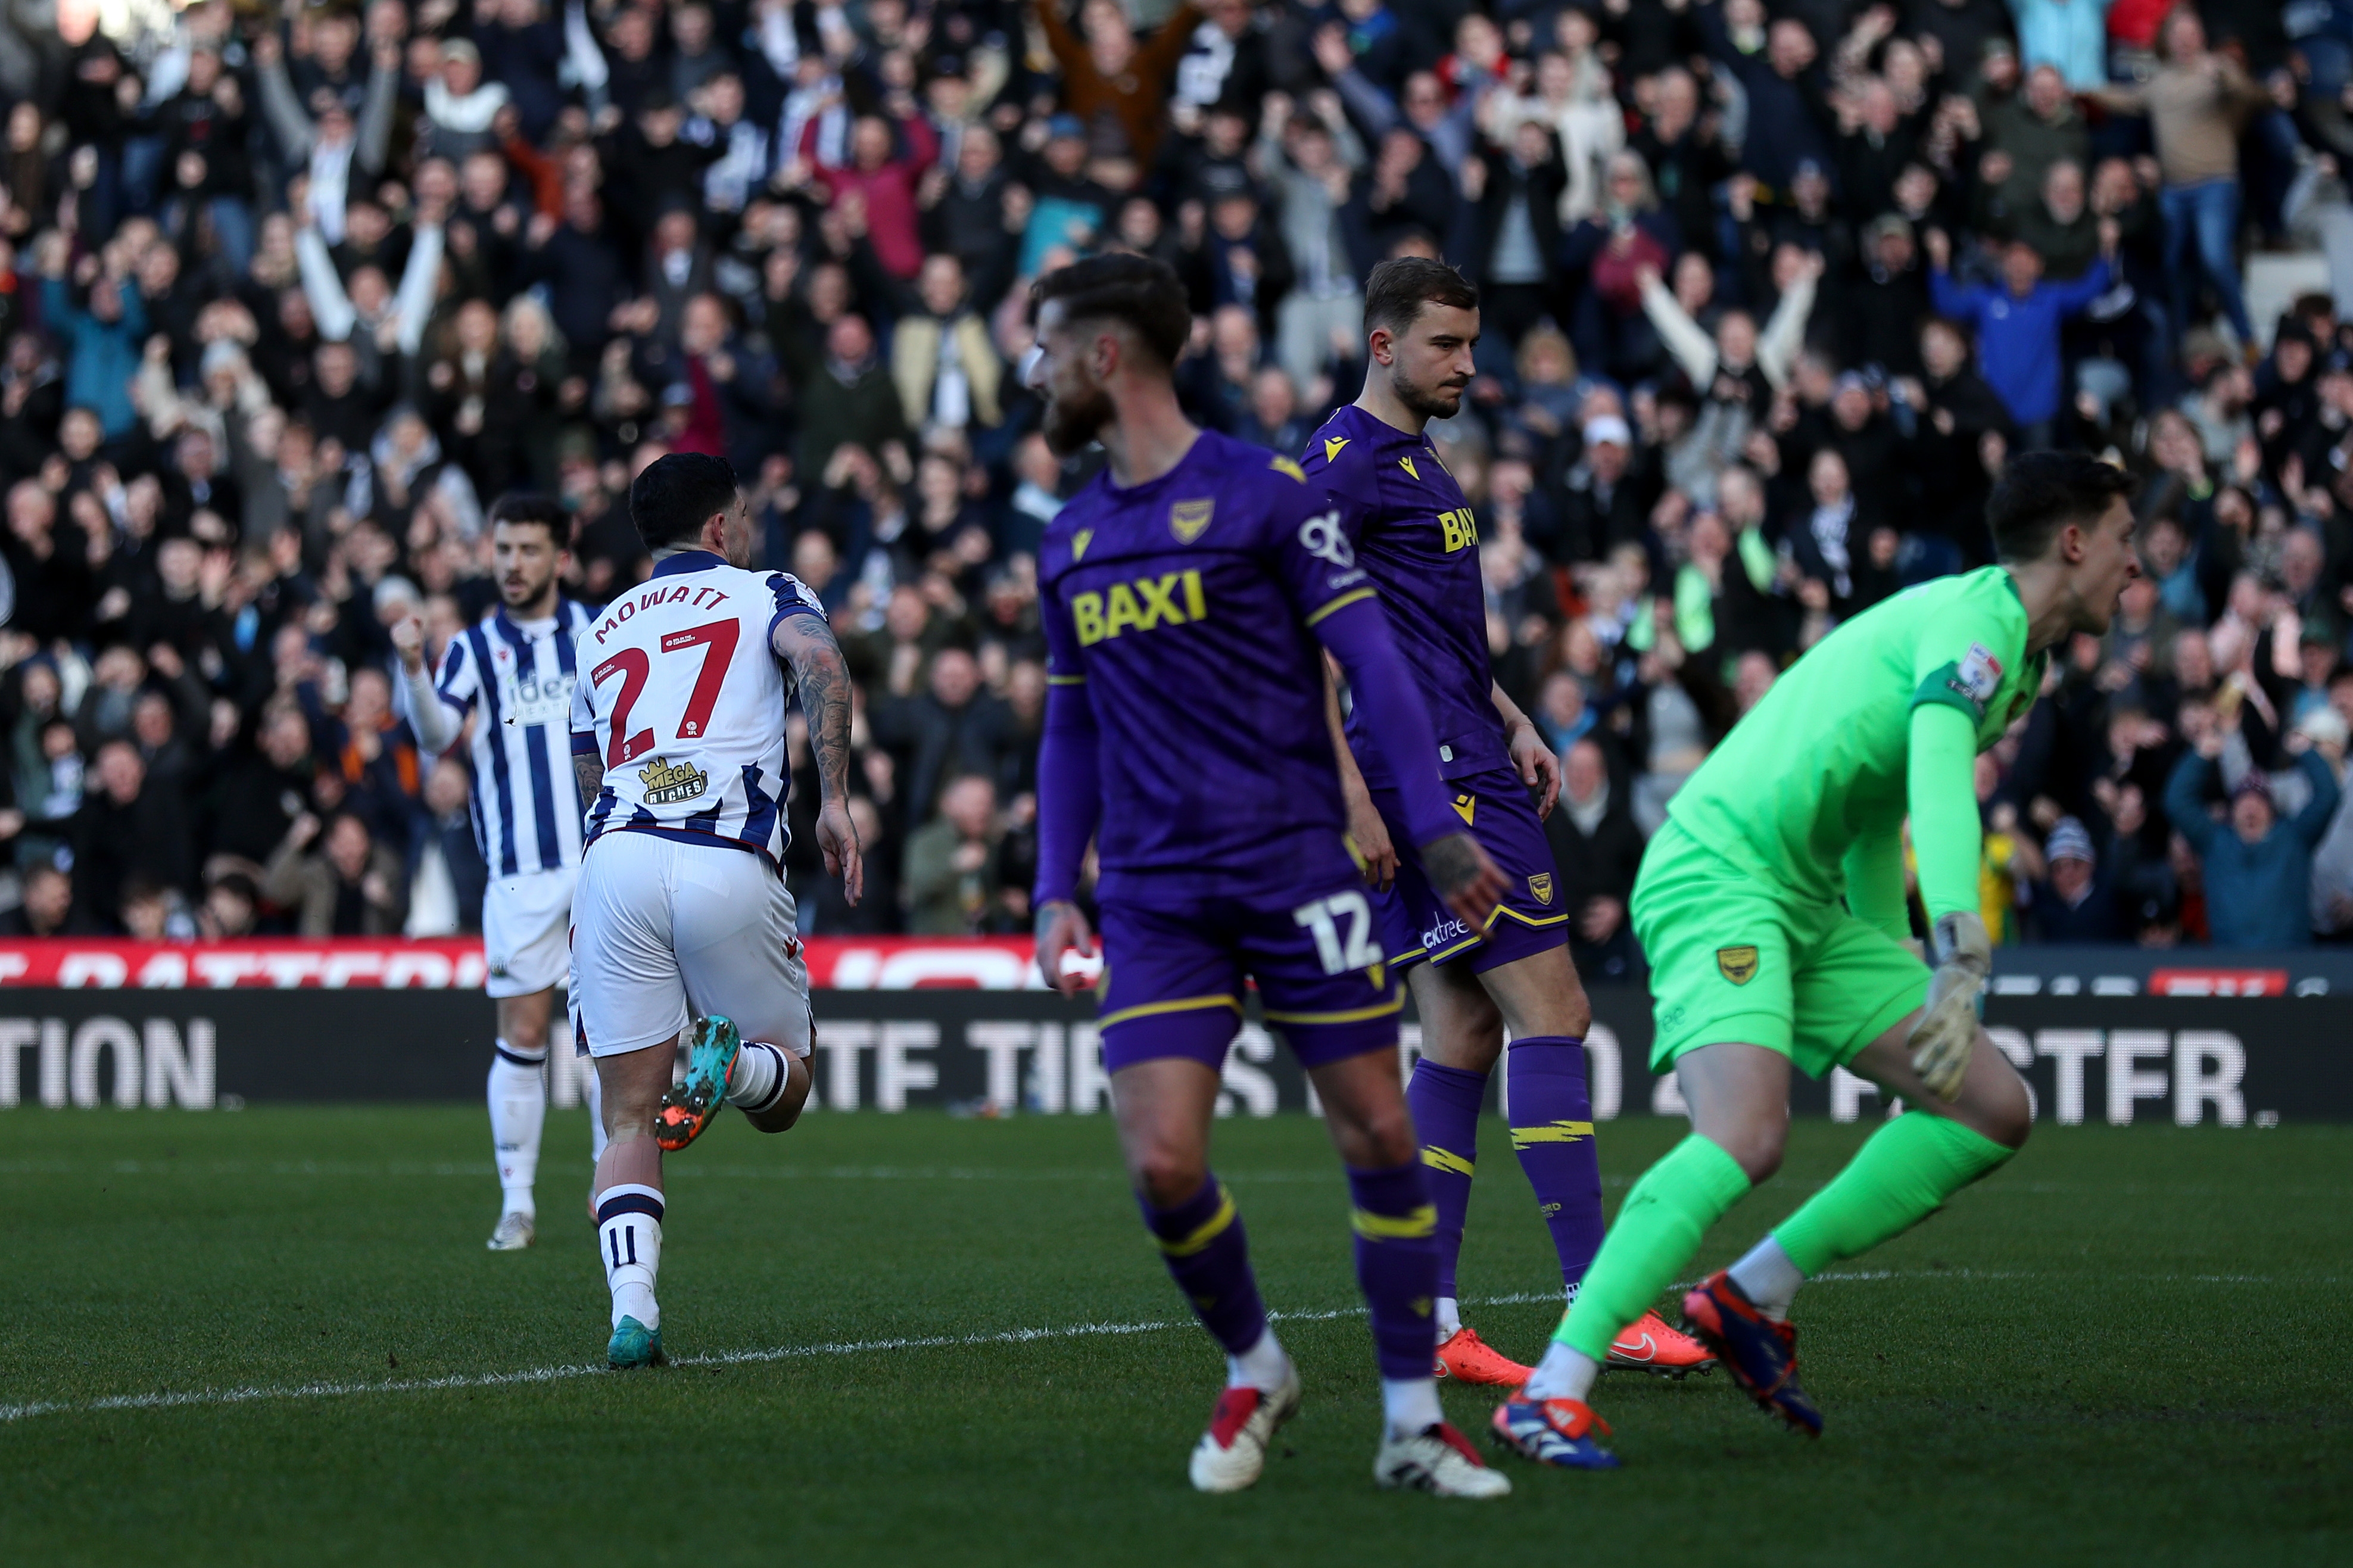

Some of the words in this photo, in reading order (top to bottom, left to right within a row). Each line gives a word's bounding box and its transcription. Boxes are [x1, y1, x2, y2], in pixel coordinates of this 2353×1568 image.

[595, 586, 731, 645] MOWATT
[1071, 568, 1208, 648] BAXI
[590, 617, 741, 773] 27
[647, 761, 698, 790] MEGA
[649, 780, 702, 805] RICHES
[1291, 890, 1385, 977] 12
